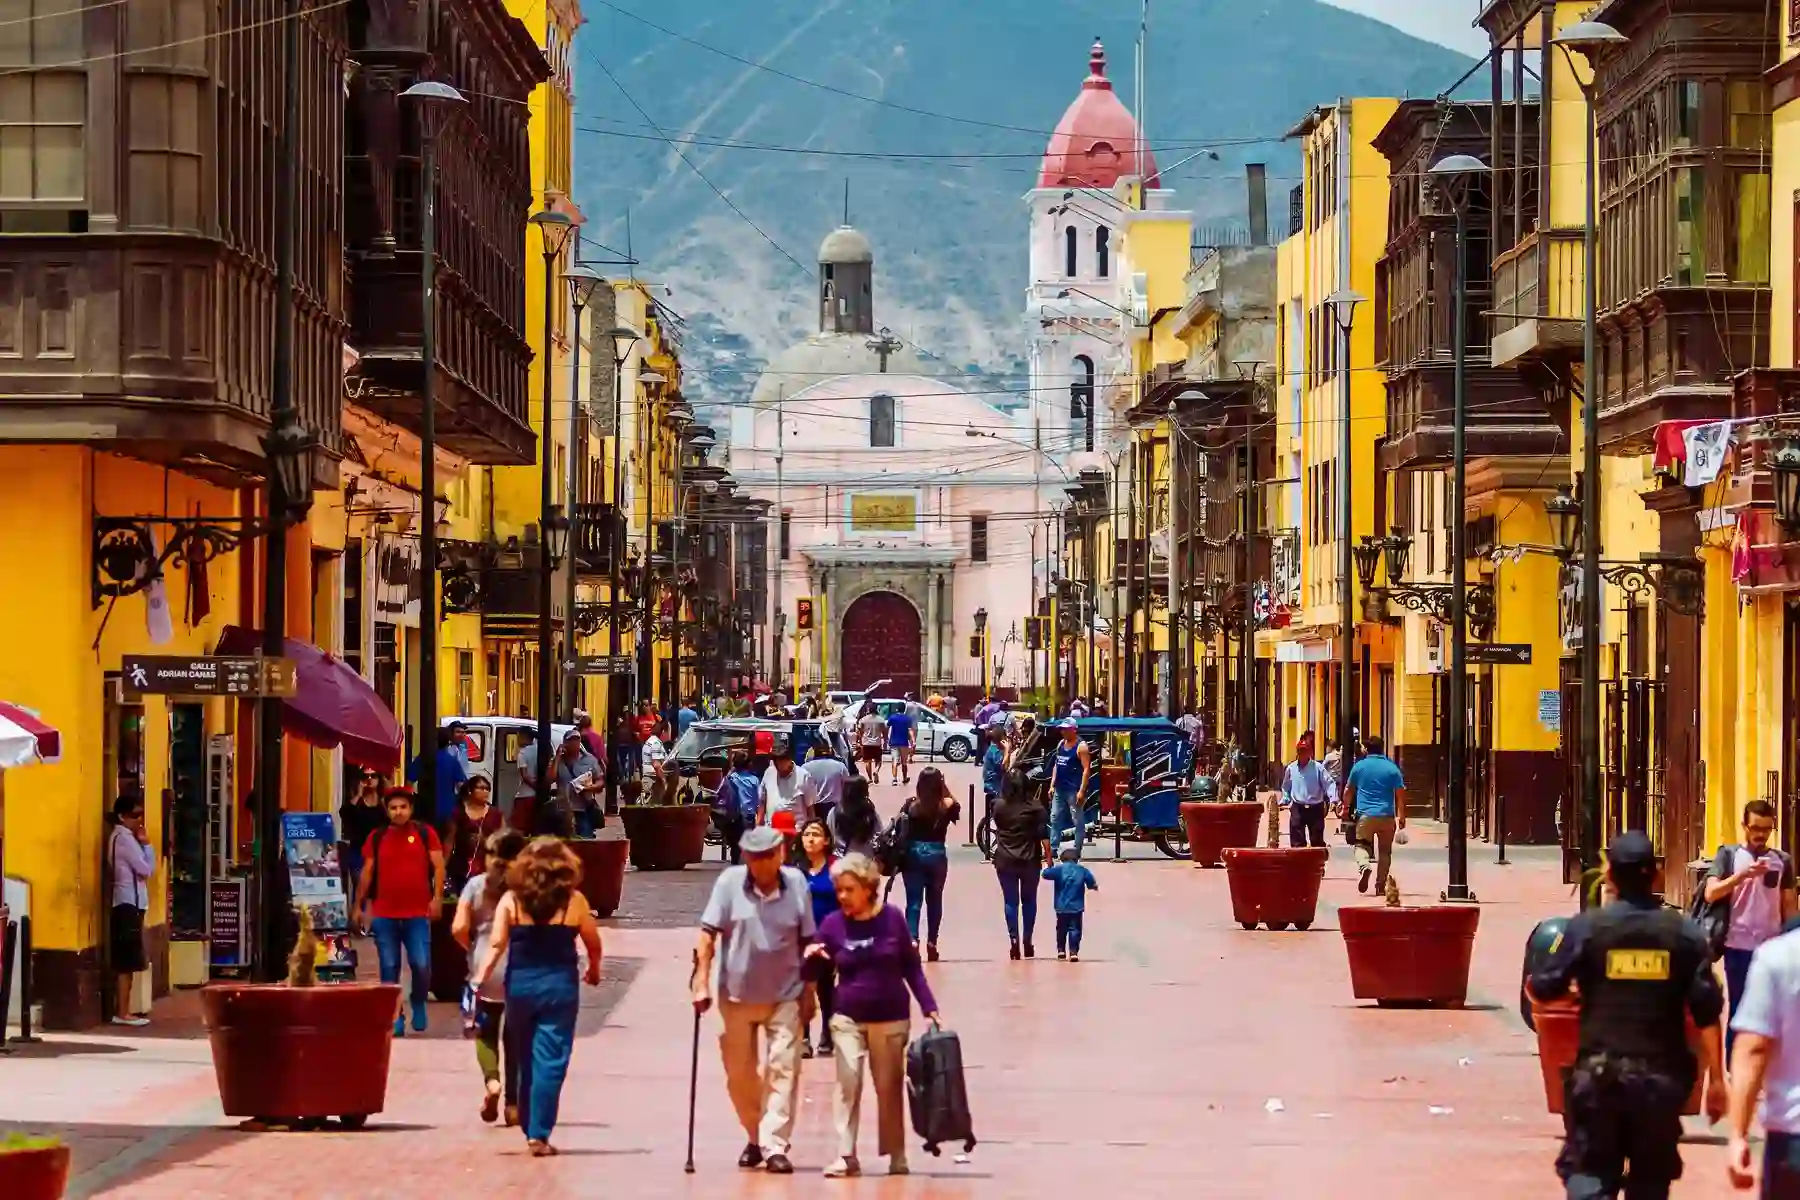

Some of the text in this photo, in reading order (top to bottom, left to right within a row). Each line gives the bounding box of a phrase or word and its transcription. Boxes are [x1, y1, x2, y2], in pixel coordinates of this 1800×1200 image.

[190, 662, 216, 670] CALLE
[157, 670, 187, 678] ADRIAN
[287, 829, 316, 838] GRATIS
